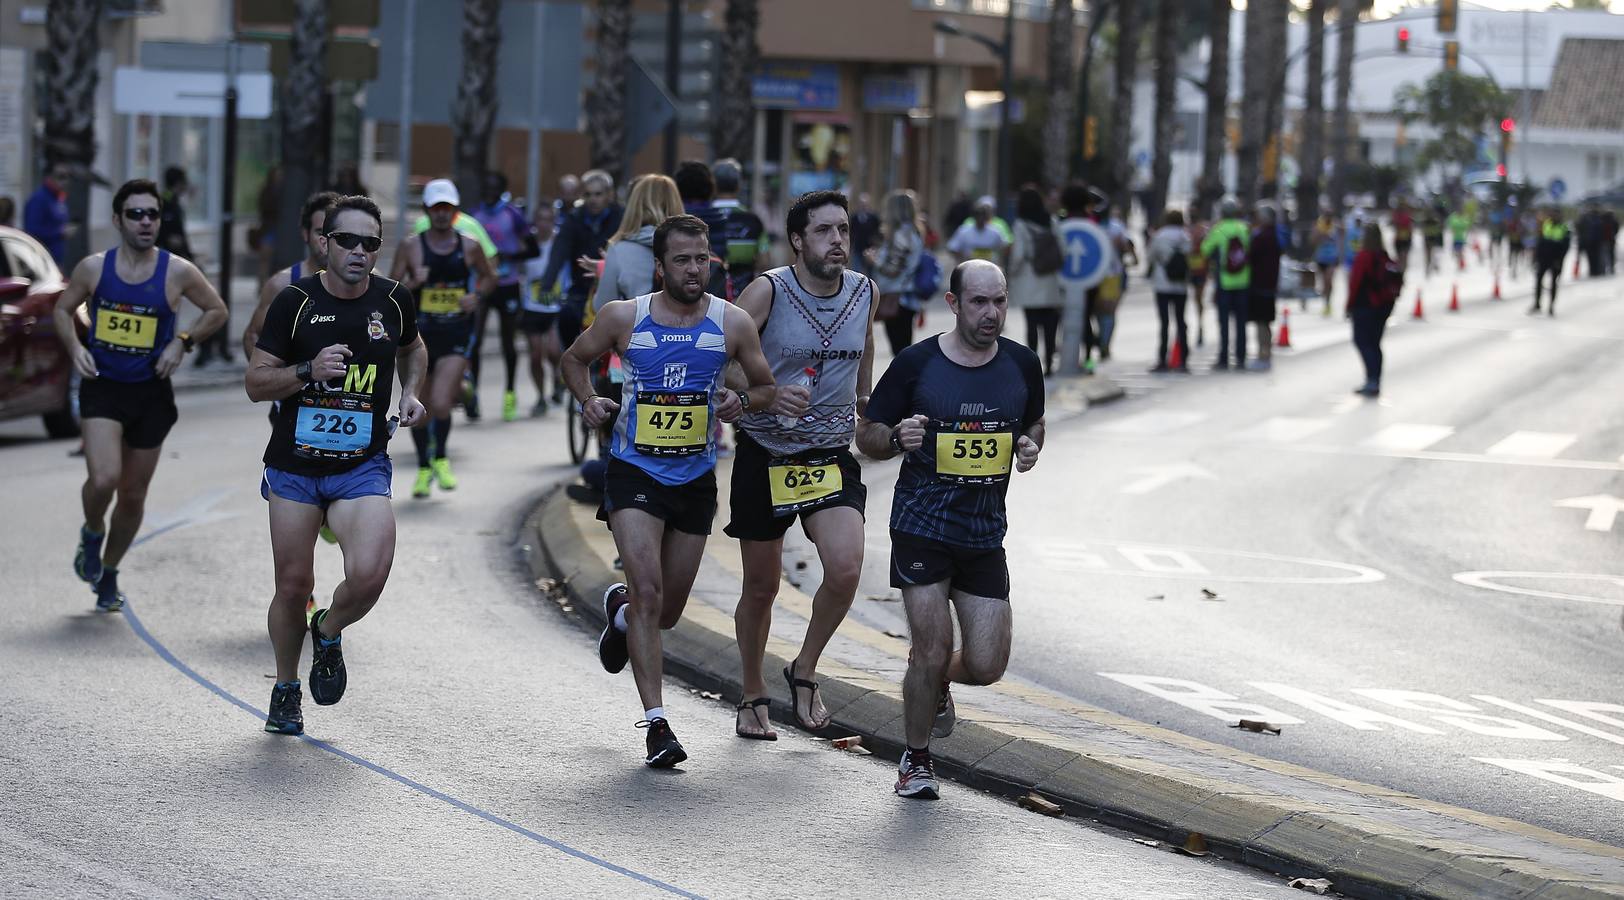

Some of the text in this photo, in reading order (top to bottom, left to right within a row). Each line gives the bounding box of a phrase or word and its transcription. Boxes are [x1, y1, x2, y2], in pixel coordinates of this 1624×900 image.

[107, 316, 142, 334] 541
[318, 315, 336, 323] asics
[960, 403, 985, 416] RUN
[311, 413, 358, 436] 226
[648, 411, 693, 430] 475
[952, 438, 998, 459] 553
[784, 469, 826, 488] 629
